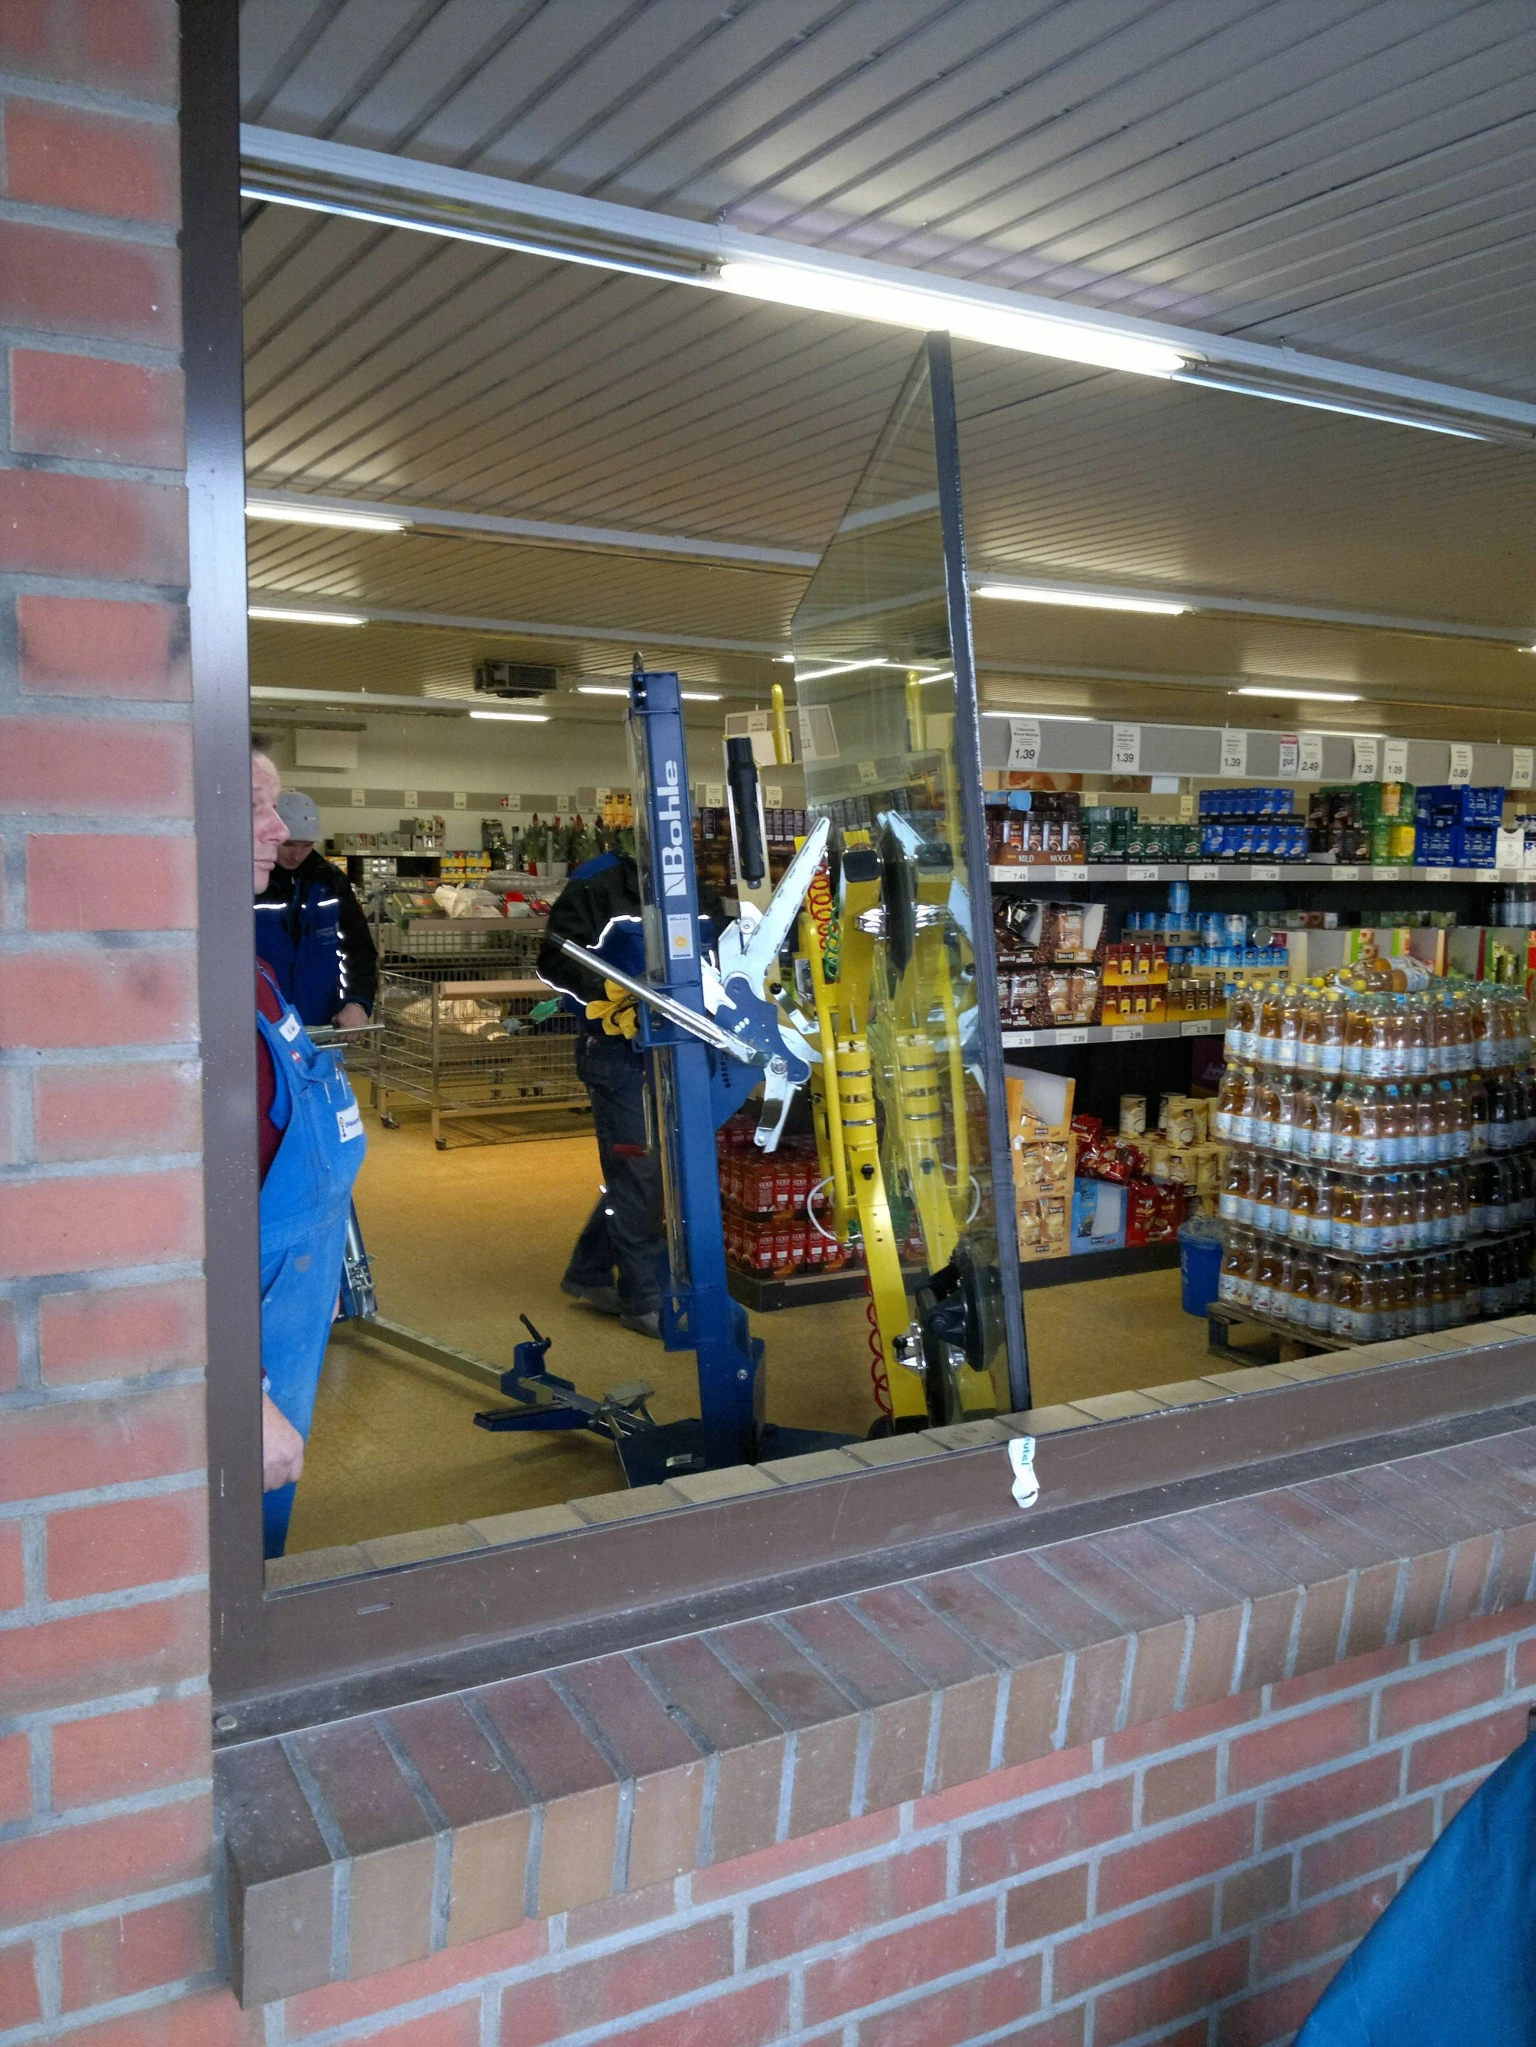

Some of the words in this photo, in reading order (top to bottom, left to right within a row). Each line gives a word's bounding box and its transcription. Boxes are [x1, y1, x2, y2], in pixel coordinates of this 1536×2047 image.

[1015, 749, 1035, 760] 1.39
[1116, 753, 1134, 763] 1.39
[1224, 758, 1241, 768] 1.39
[1301, 761, 1319, 772] 2.49
[1357, 764, 1374, 774] 1.29
[657, 760, 686, 874] Bohle
[1018, 853, 1035, 863] MILD
[1050, 854, 1072, 863] MOCCA
